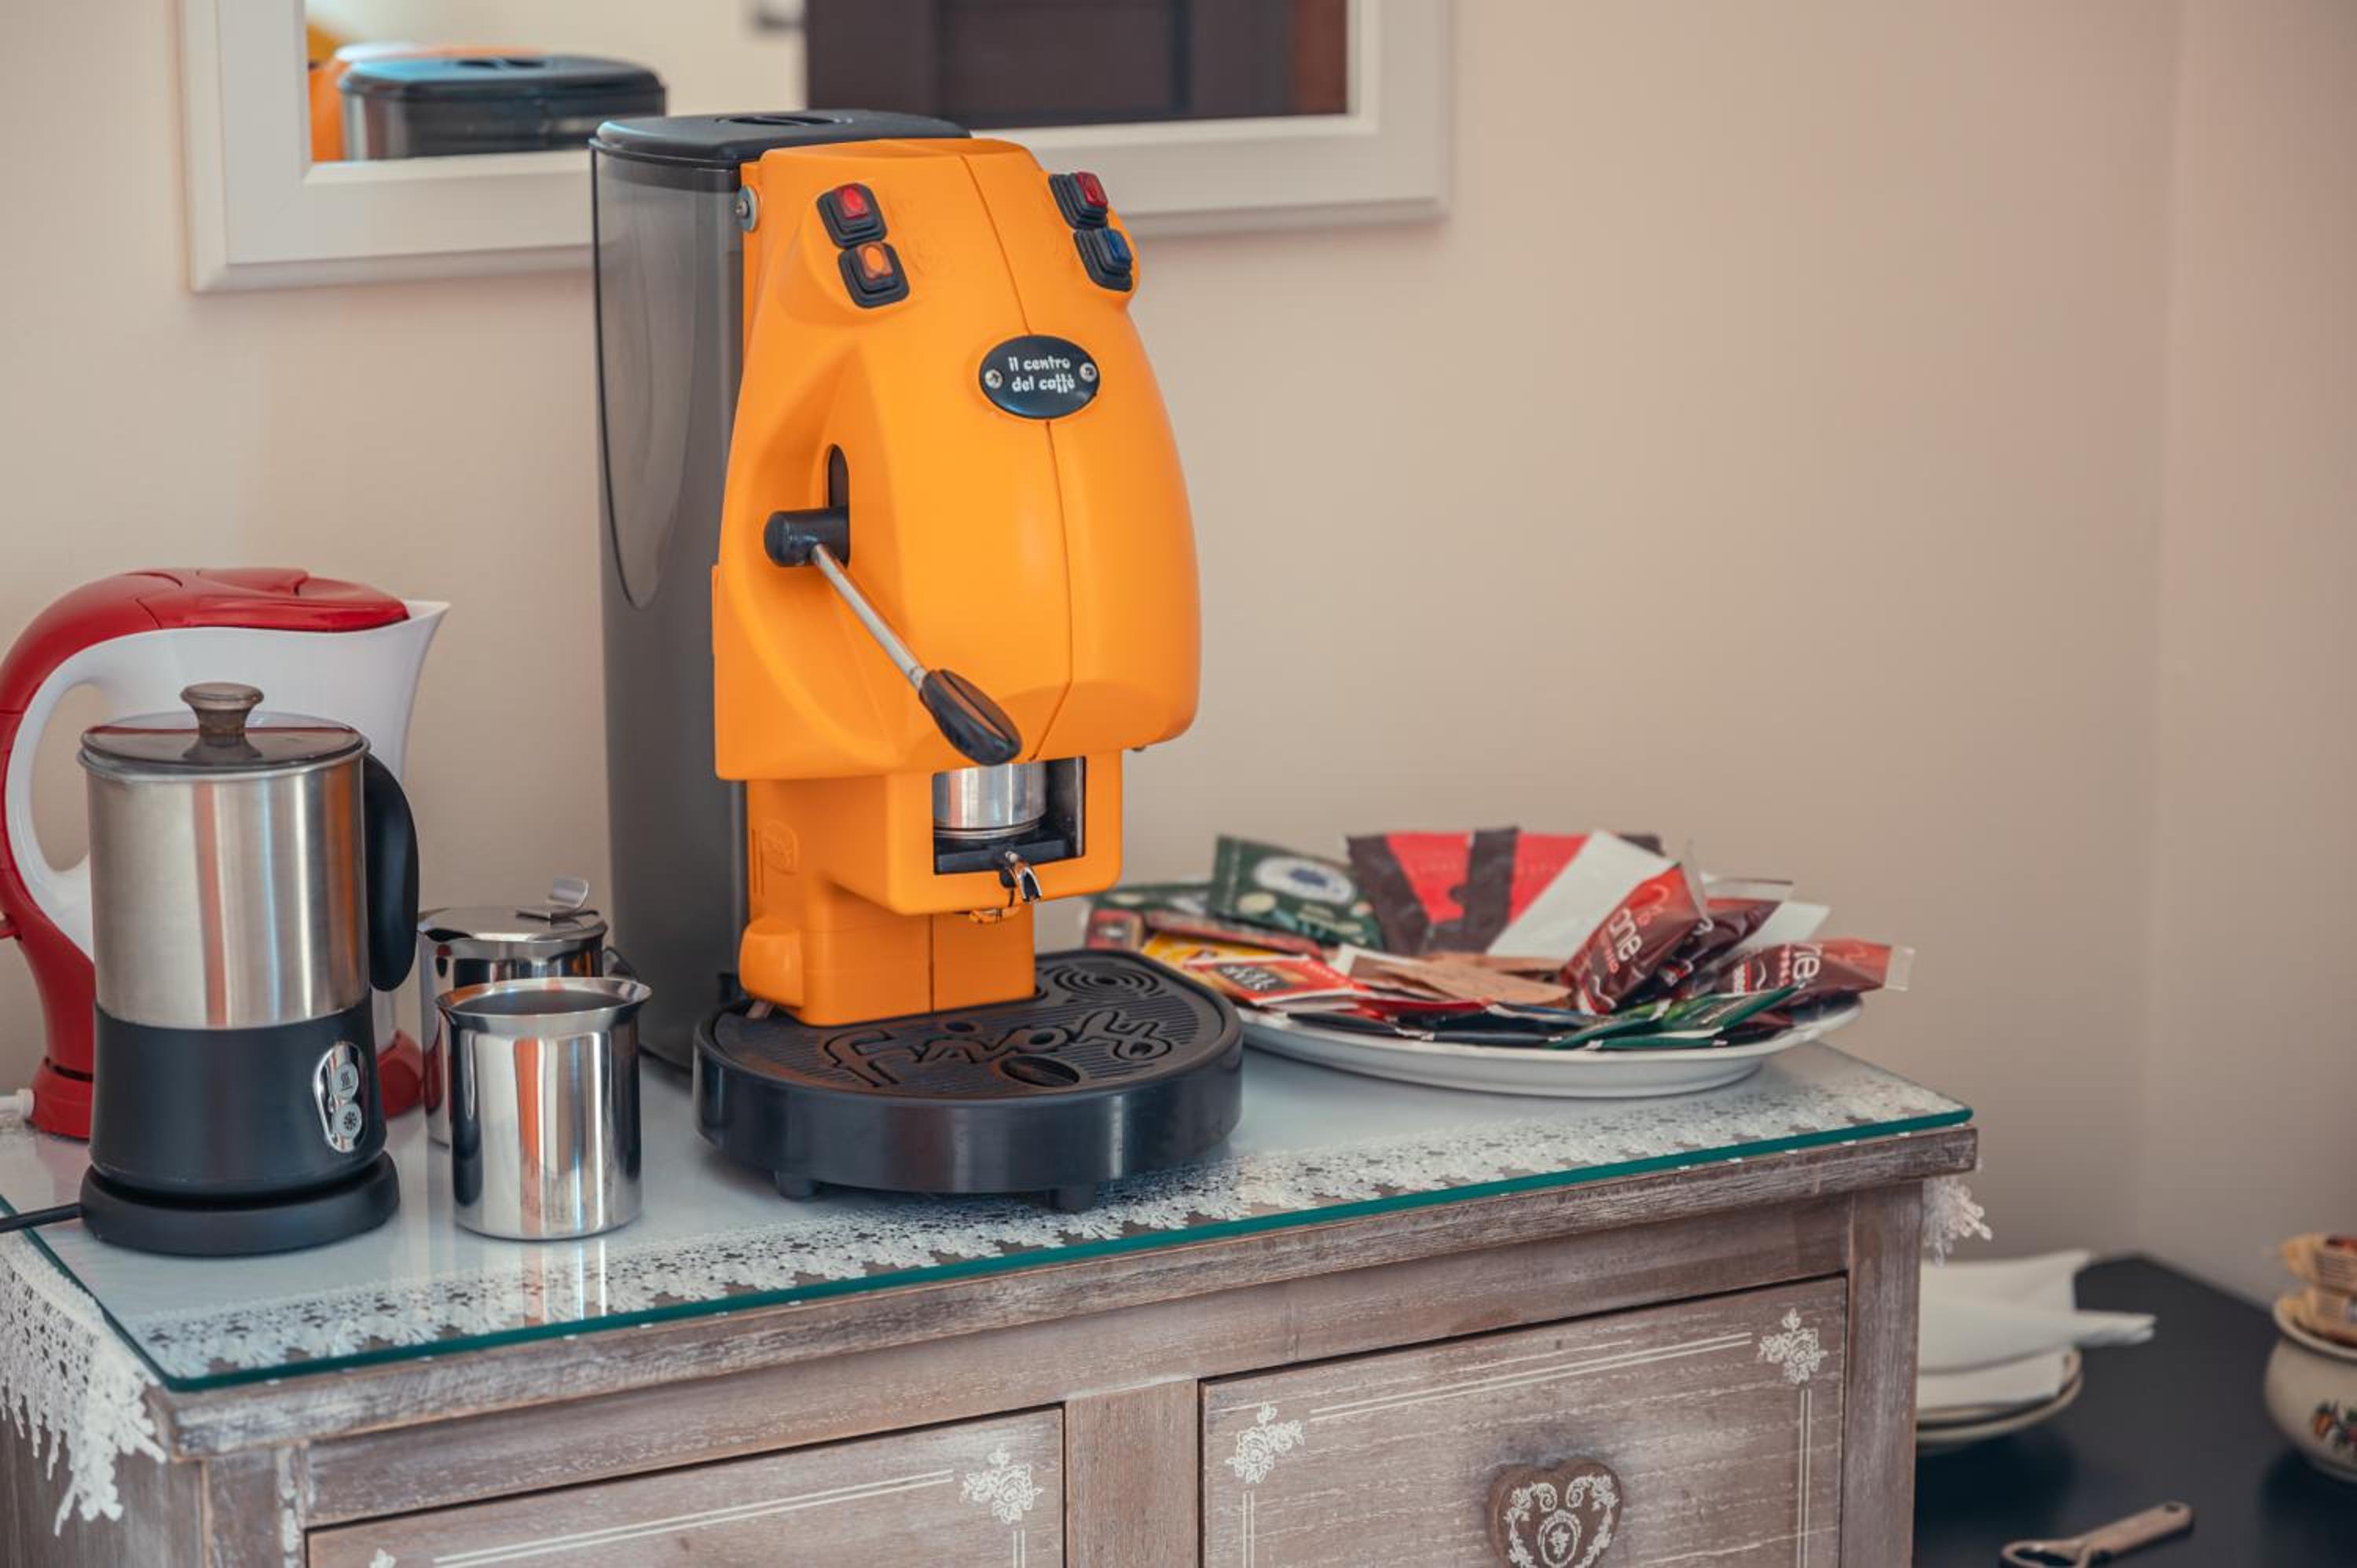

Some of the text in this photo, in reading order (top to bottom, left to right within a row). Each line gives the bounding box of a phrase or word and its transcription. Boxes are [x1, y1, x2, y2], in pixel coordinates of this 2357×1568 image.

[1024, 355, 1071, 371] centro
[1011, 373, 1076, 394] del caffè
